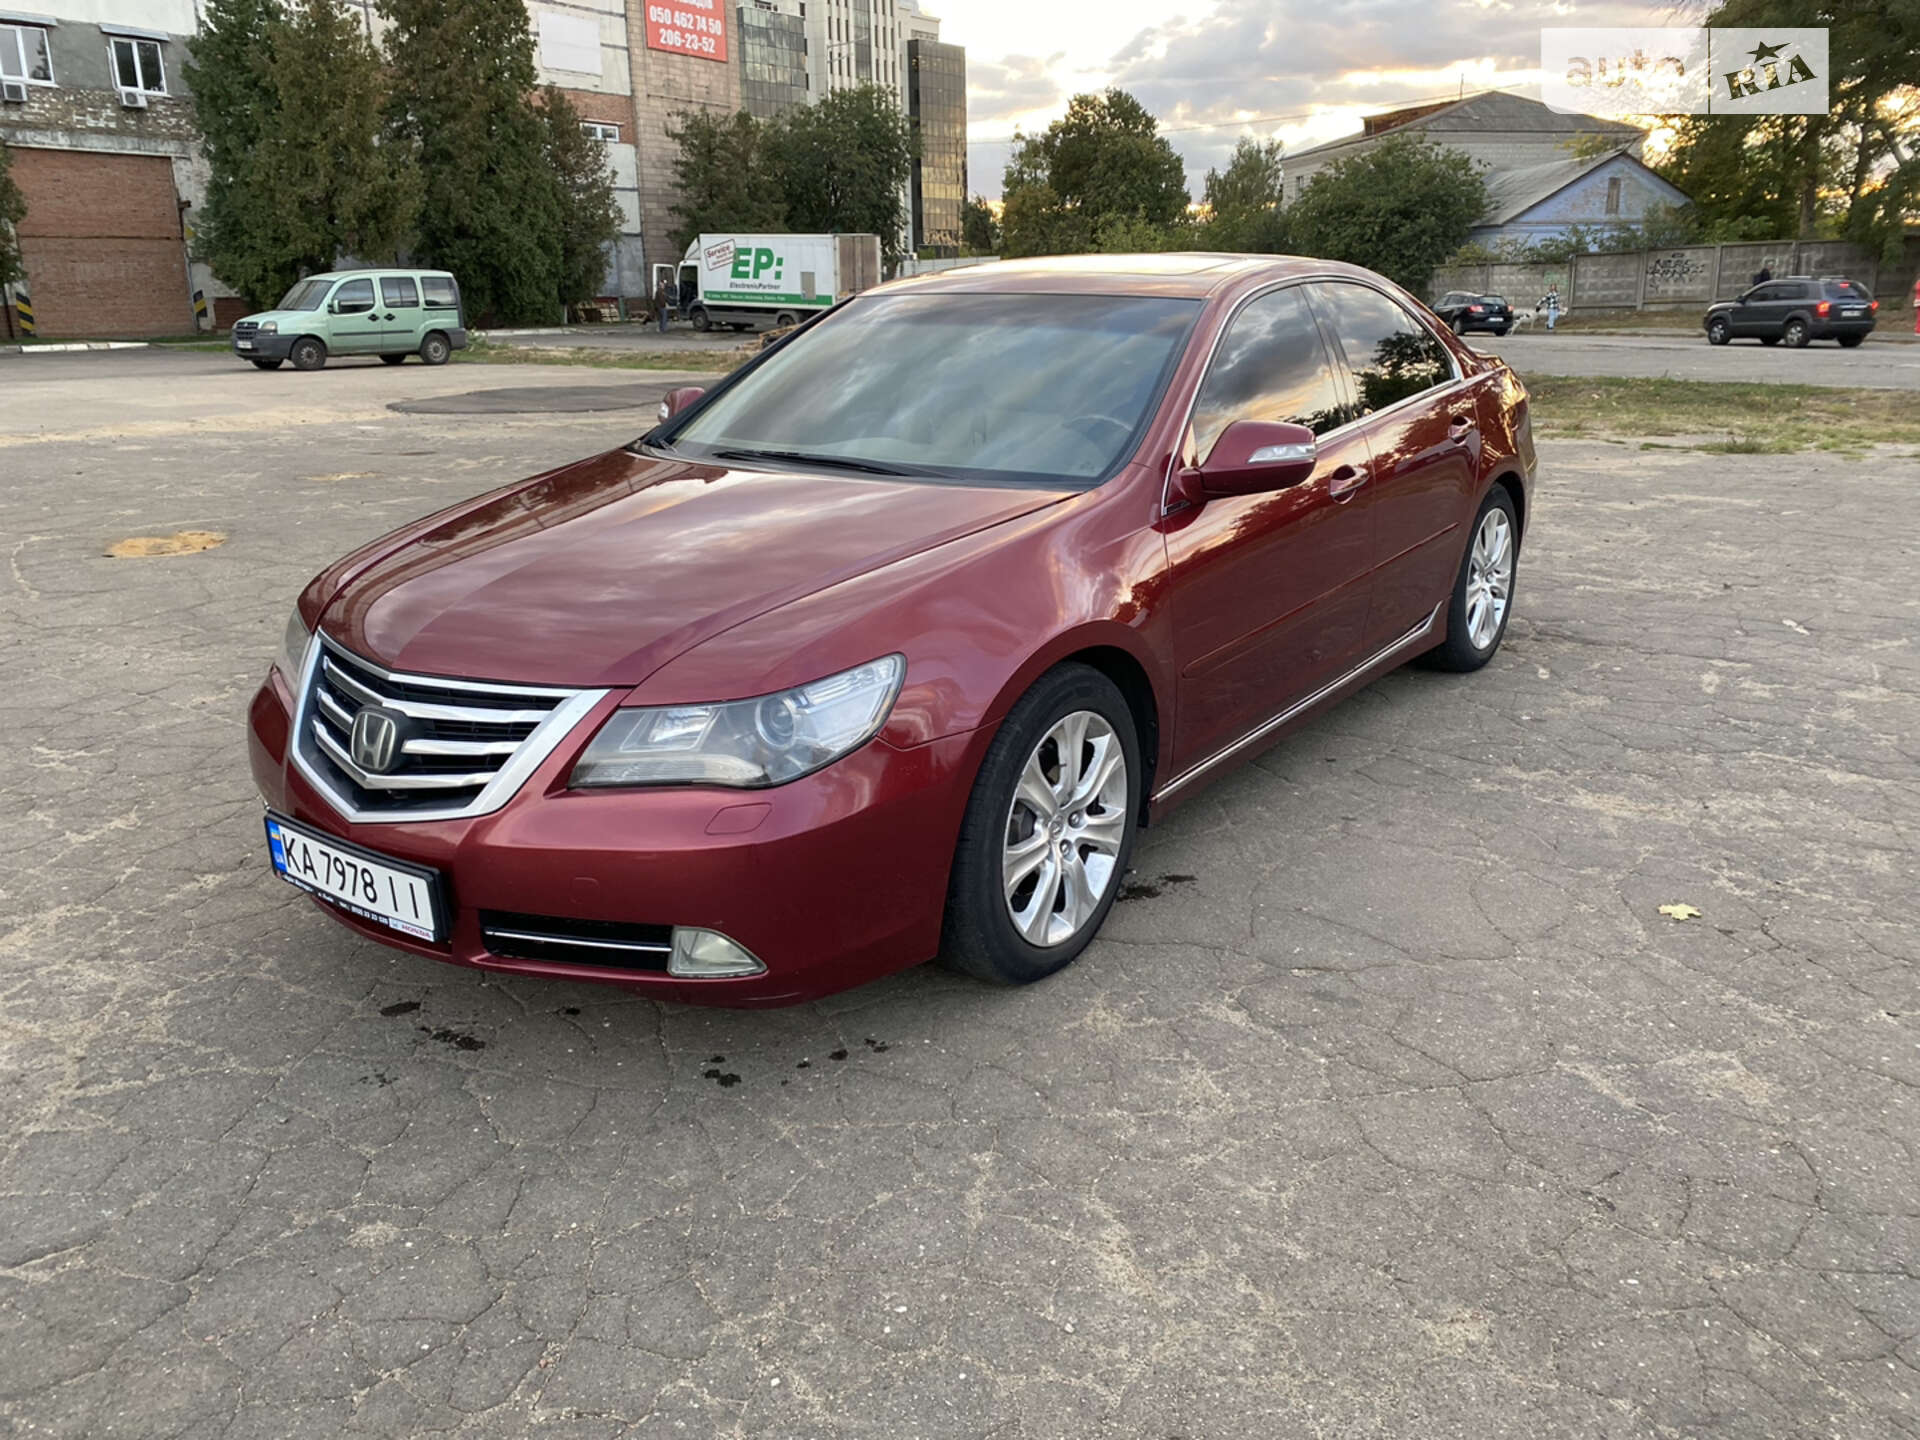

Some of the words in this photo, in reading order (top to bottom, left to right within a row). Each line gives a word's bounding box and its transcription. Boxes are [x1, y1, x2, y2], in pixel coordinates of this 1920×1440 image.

[649, 5, 672, 25] 050
[673, 11, 695, 30] 462
[696, 15, 708, 32] 74
[708, 19, 722, 36] 50
[659, 28, 716, 54] 206-23-52
[282, 833, 318, 881] KA
[319, 851, 378, 904] 7978
[401, 924, 432, 939] HONDA
